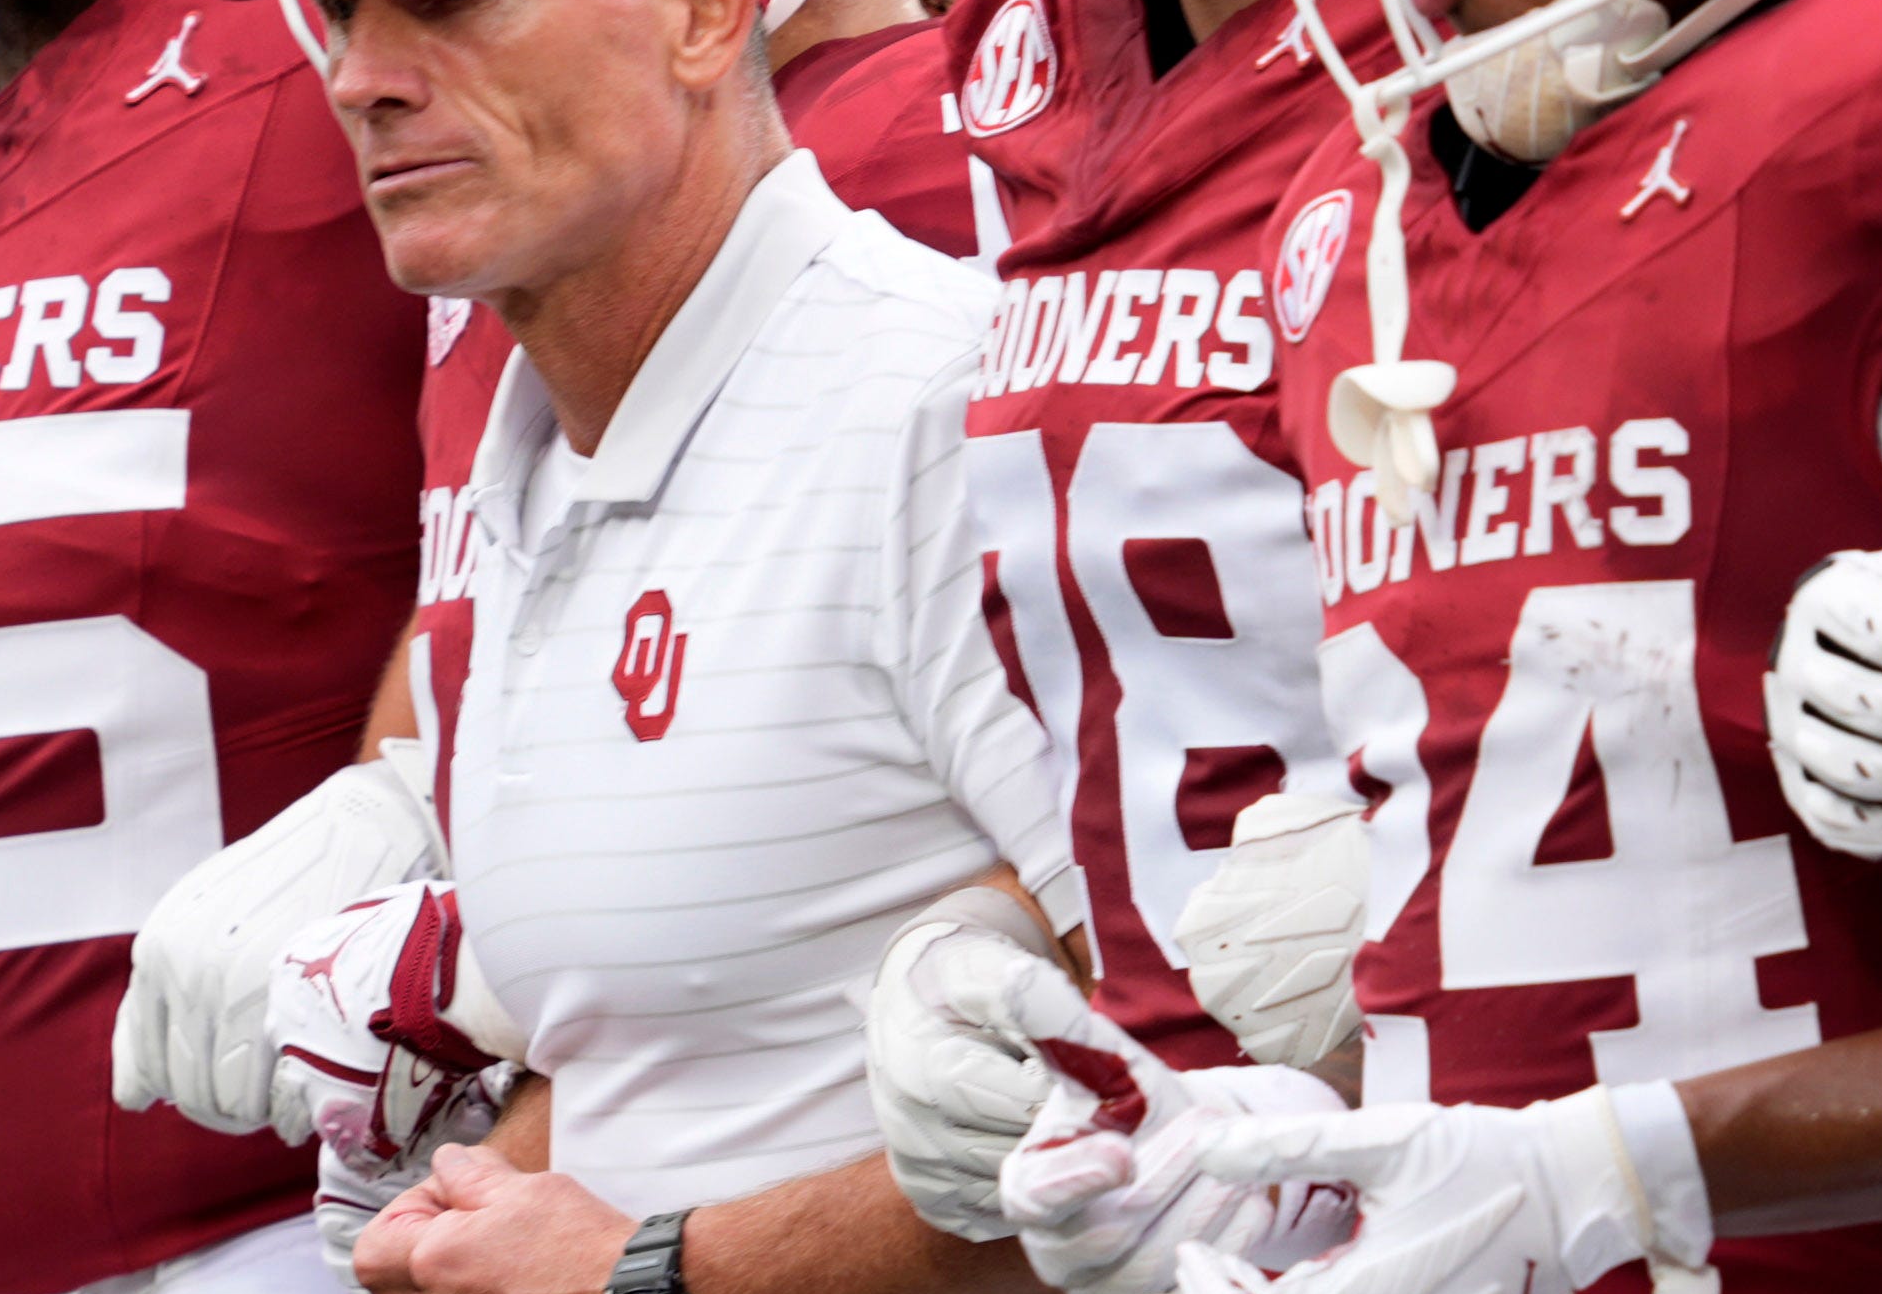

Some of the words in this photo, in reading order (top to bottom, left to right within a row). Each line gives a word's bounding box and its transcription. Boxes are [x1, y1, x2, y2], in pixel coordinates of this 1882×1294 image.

[967, 4, 1050, 126] SEC
[1279, 201, 1345, 329] SEC
[1307, 417, 1691, 607] OONERS
[610, 588, 688, 743] OU
